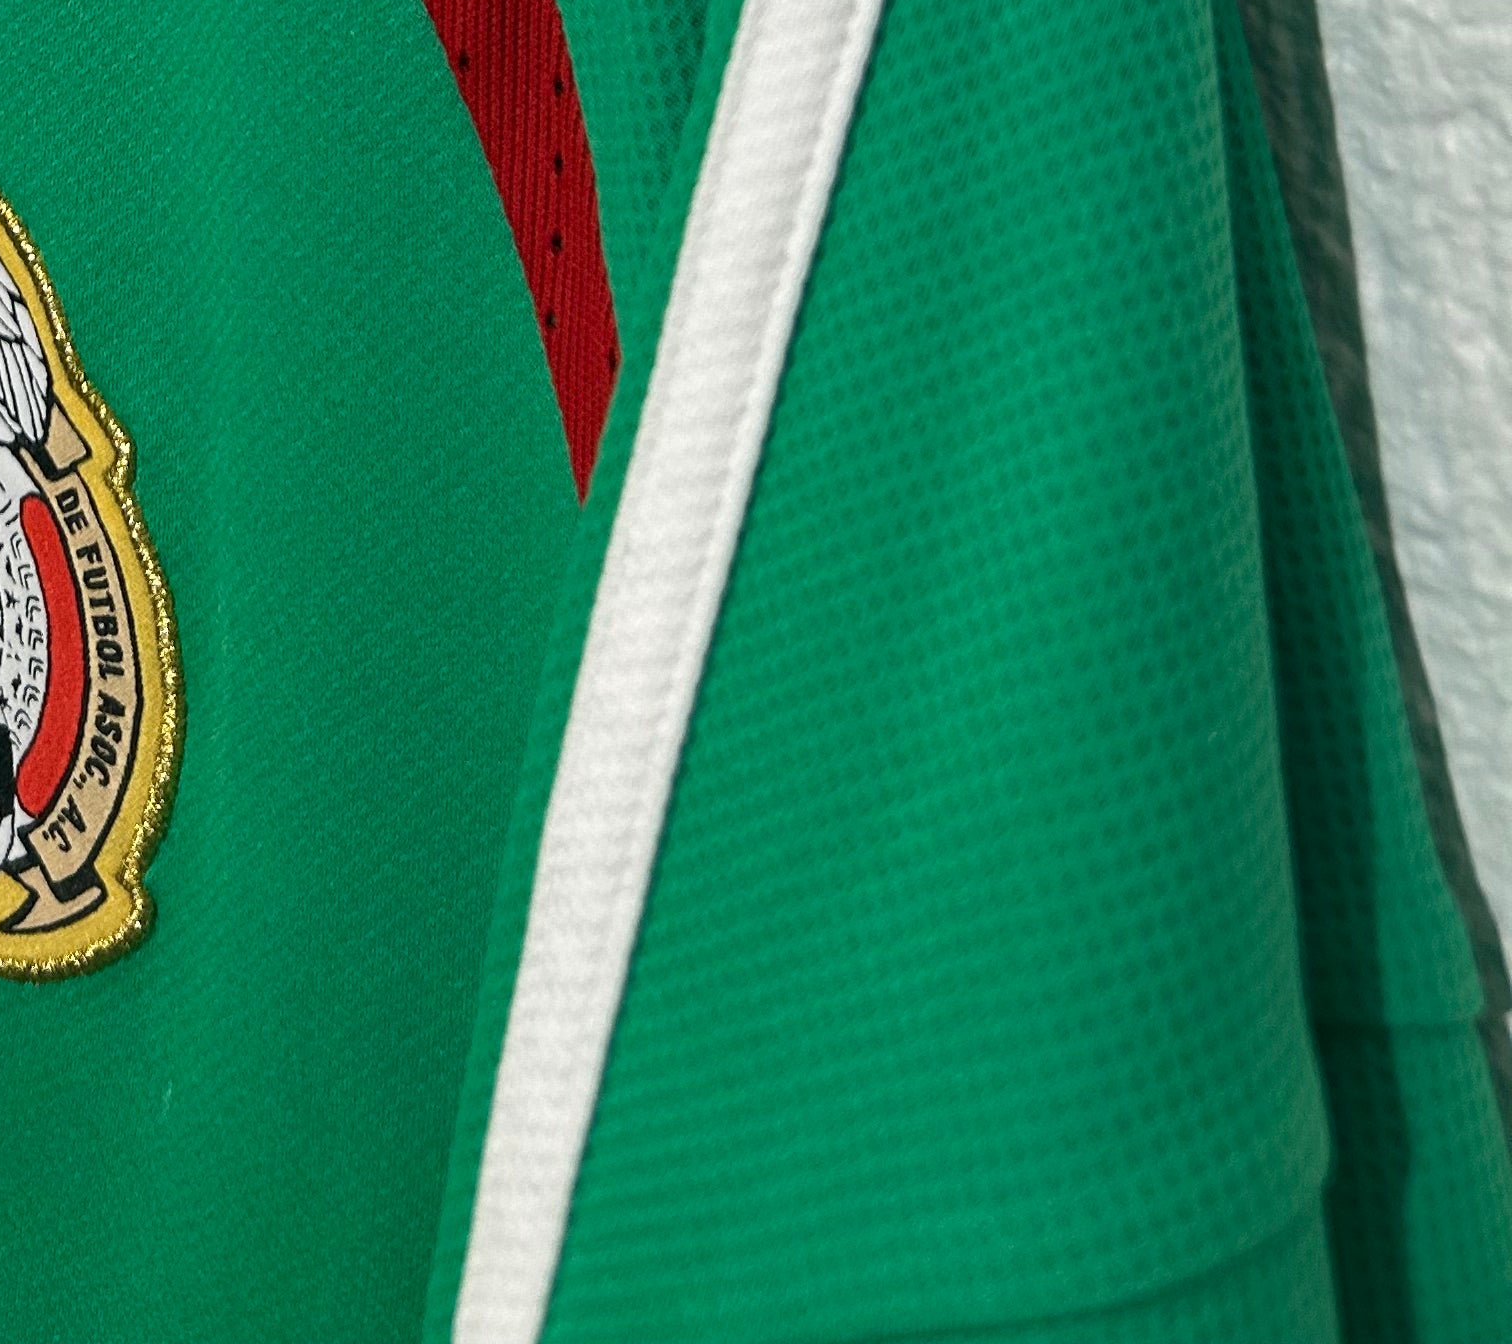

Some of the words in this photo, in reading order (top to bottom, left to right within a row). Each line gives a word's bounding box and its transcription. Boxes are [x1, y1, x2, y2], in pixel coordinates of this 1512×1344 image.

[55, 486, 88, 535] DE
[76, 540, 125, 682] FUTBOL
[41, 793, 88, 854] A.C.
